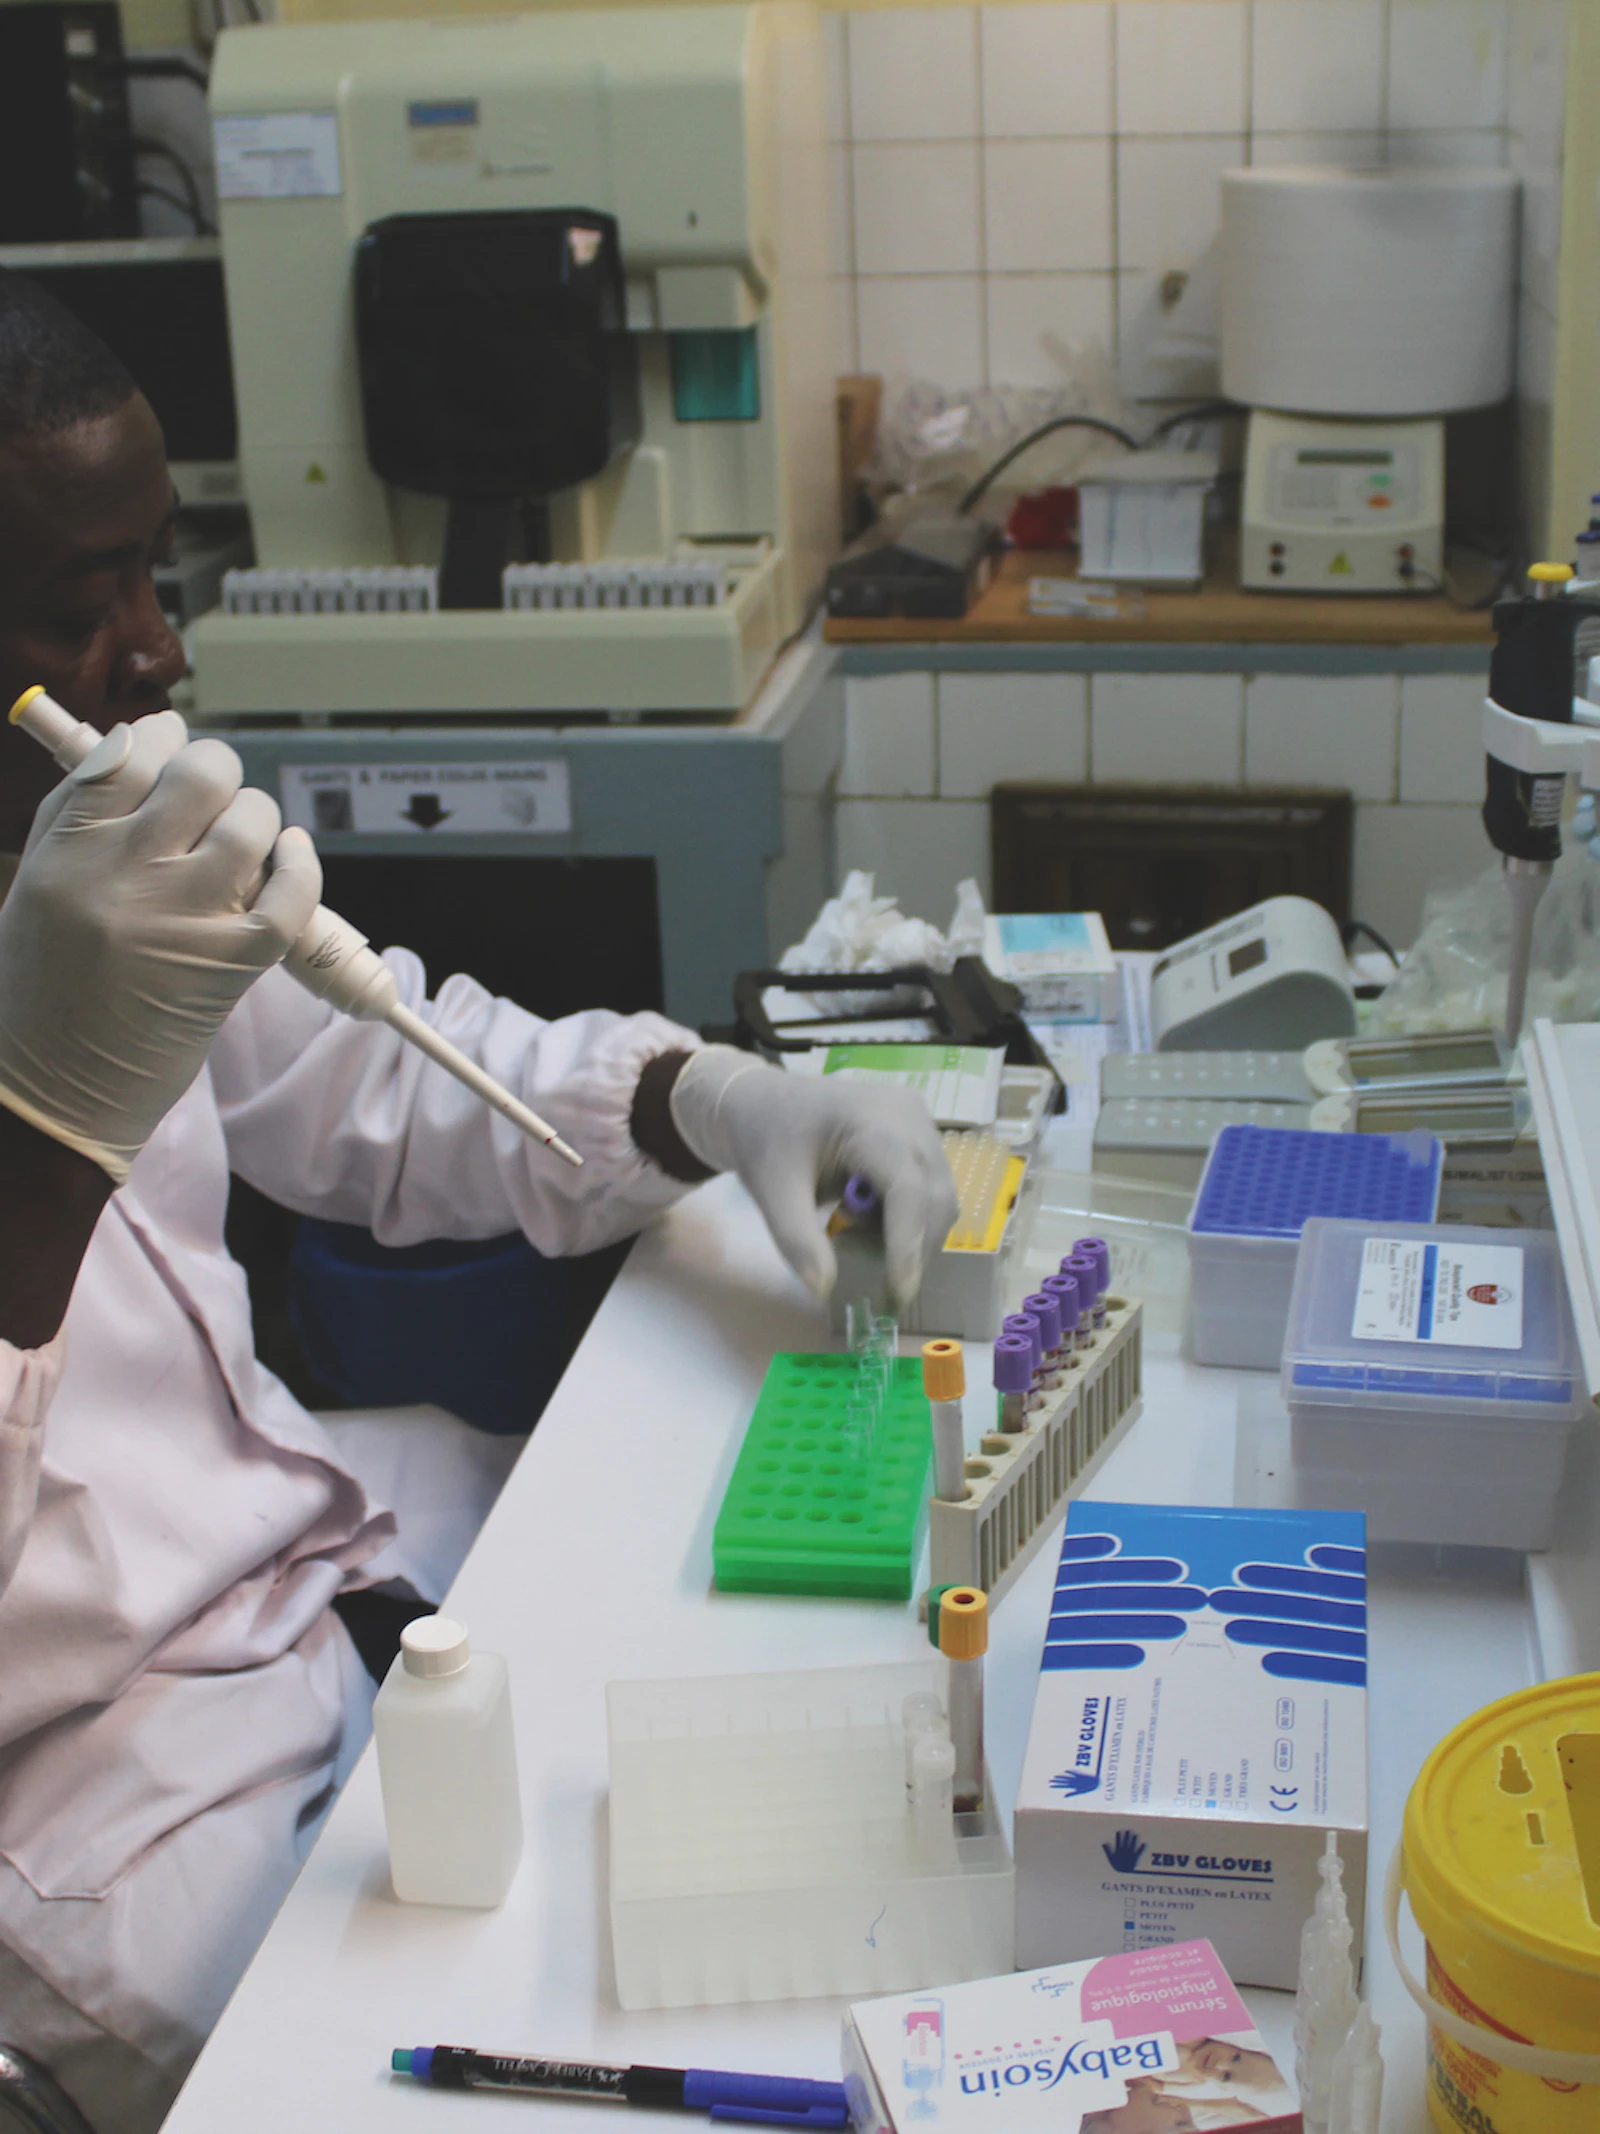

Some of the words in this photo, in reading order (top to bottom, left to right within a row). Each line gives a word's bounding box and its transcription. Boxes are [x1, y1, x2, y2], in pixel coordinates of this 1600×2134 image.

[1079, 1696, 1099, 1741] GLOVES
[1281, 1717, 1290, 1727] ISO
[1074, 1743, 1092, 1767] ZBV
[1103, 1771, 1119, 1802] GANTS
[1114, 1696, 1127, 1722] LATEX
[1238, 1757, 1250, 1780] GRAND
[1279, 1757, 1288, 1768] ISO
[1207, 1771, 1218, 1797] MOYEN
[1222, 1773, 1234, 1798] GRAND
[1268, 1784, 1300, 1813] CE
[1151, 1852, 1190, 1868] ZBV
[1194, 1855, 1273, 1874] GLOVES
[1101, 1880, 1144, 1894] GANTS
[1146, 1885, 1212, 1898] D'EXAMEN
[1214, 1890, 1228, 1899] en
[1229, 1890, 1272, 1902] LATEX
[1139, 1899, 1165, 1909] PLUS
[1167, 1901, 1195, 1911] PETIT
[1139, 1911, 1168, 1921] PETIT
[1138, 1934, 1175, 1944] GRAND
[1139, 1923, 1176, 1933] MOYEN
[1171, 1956, 1205, 1969] voies
[1184, 1948, 1200, 1958] et
[1127, 1964, 1169, 1977] nasale
[1089, 1978, 1218, 2012] physiologique
[1166, 1995, 1228, 2015] Sérum
[959, 2039, 1164, 2098] Babysoin
